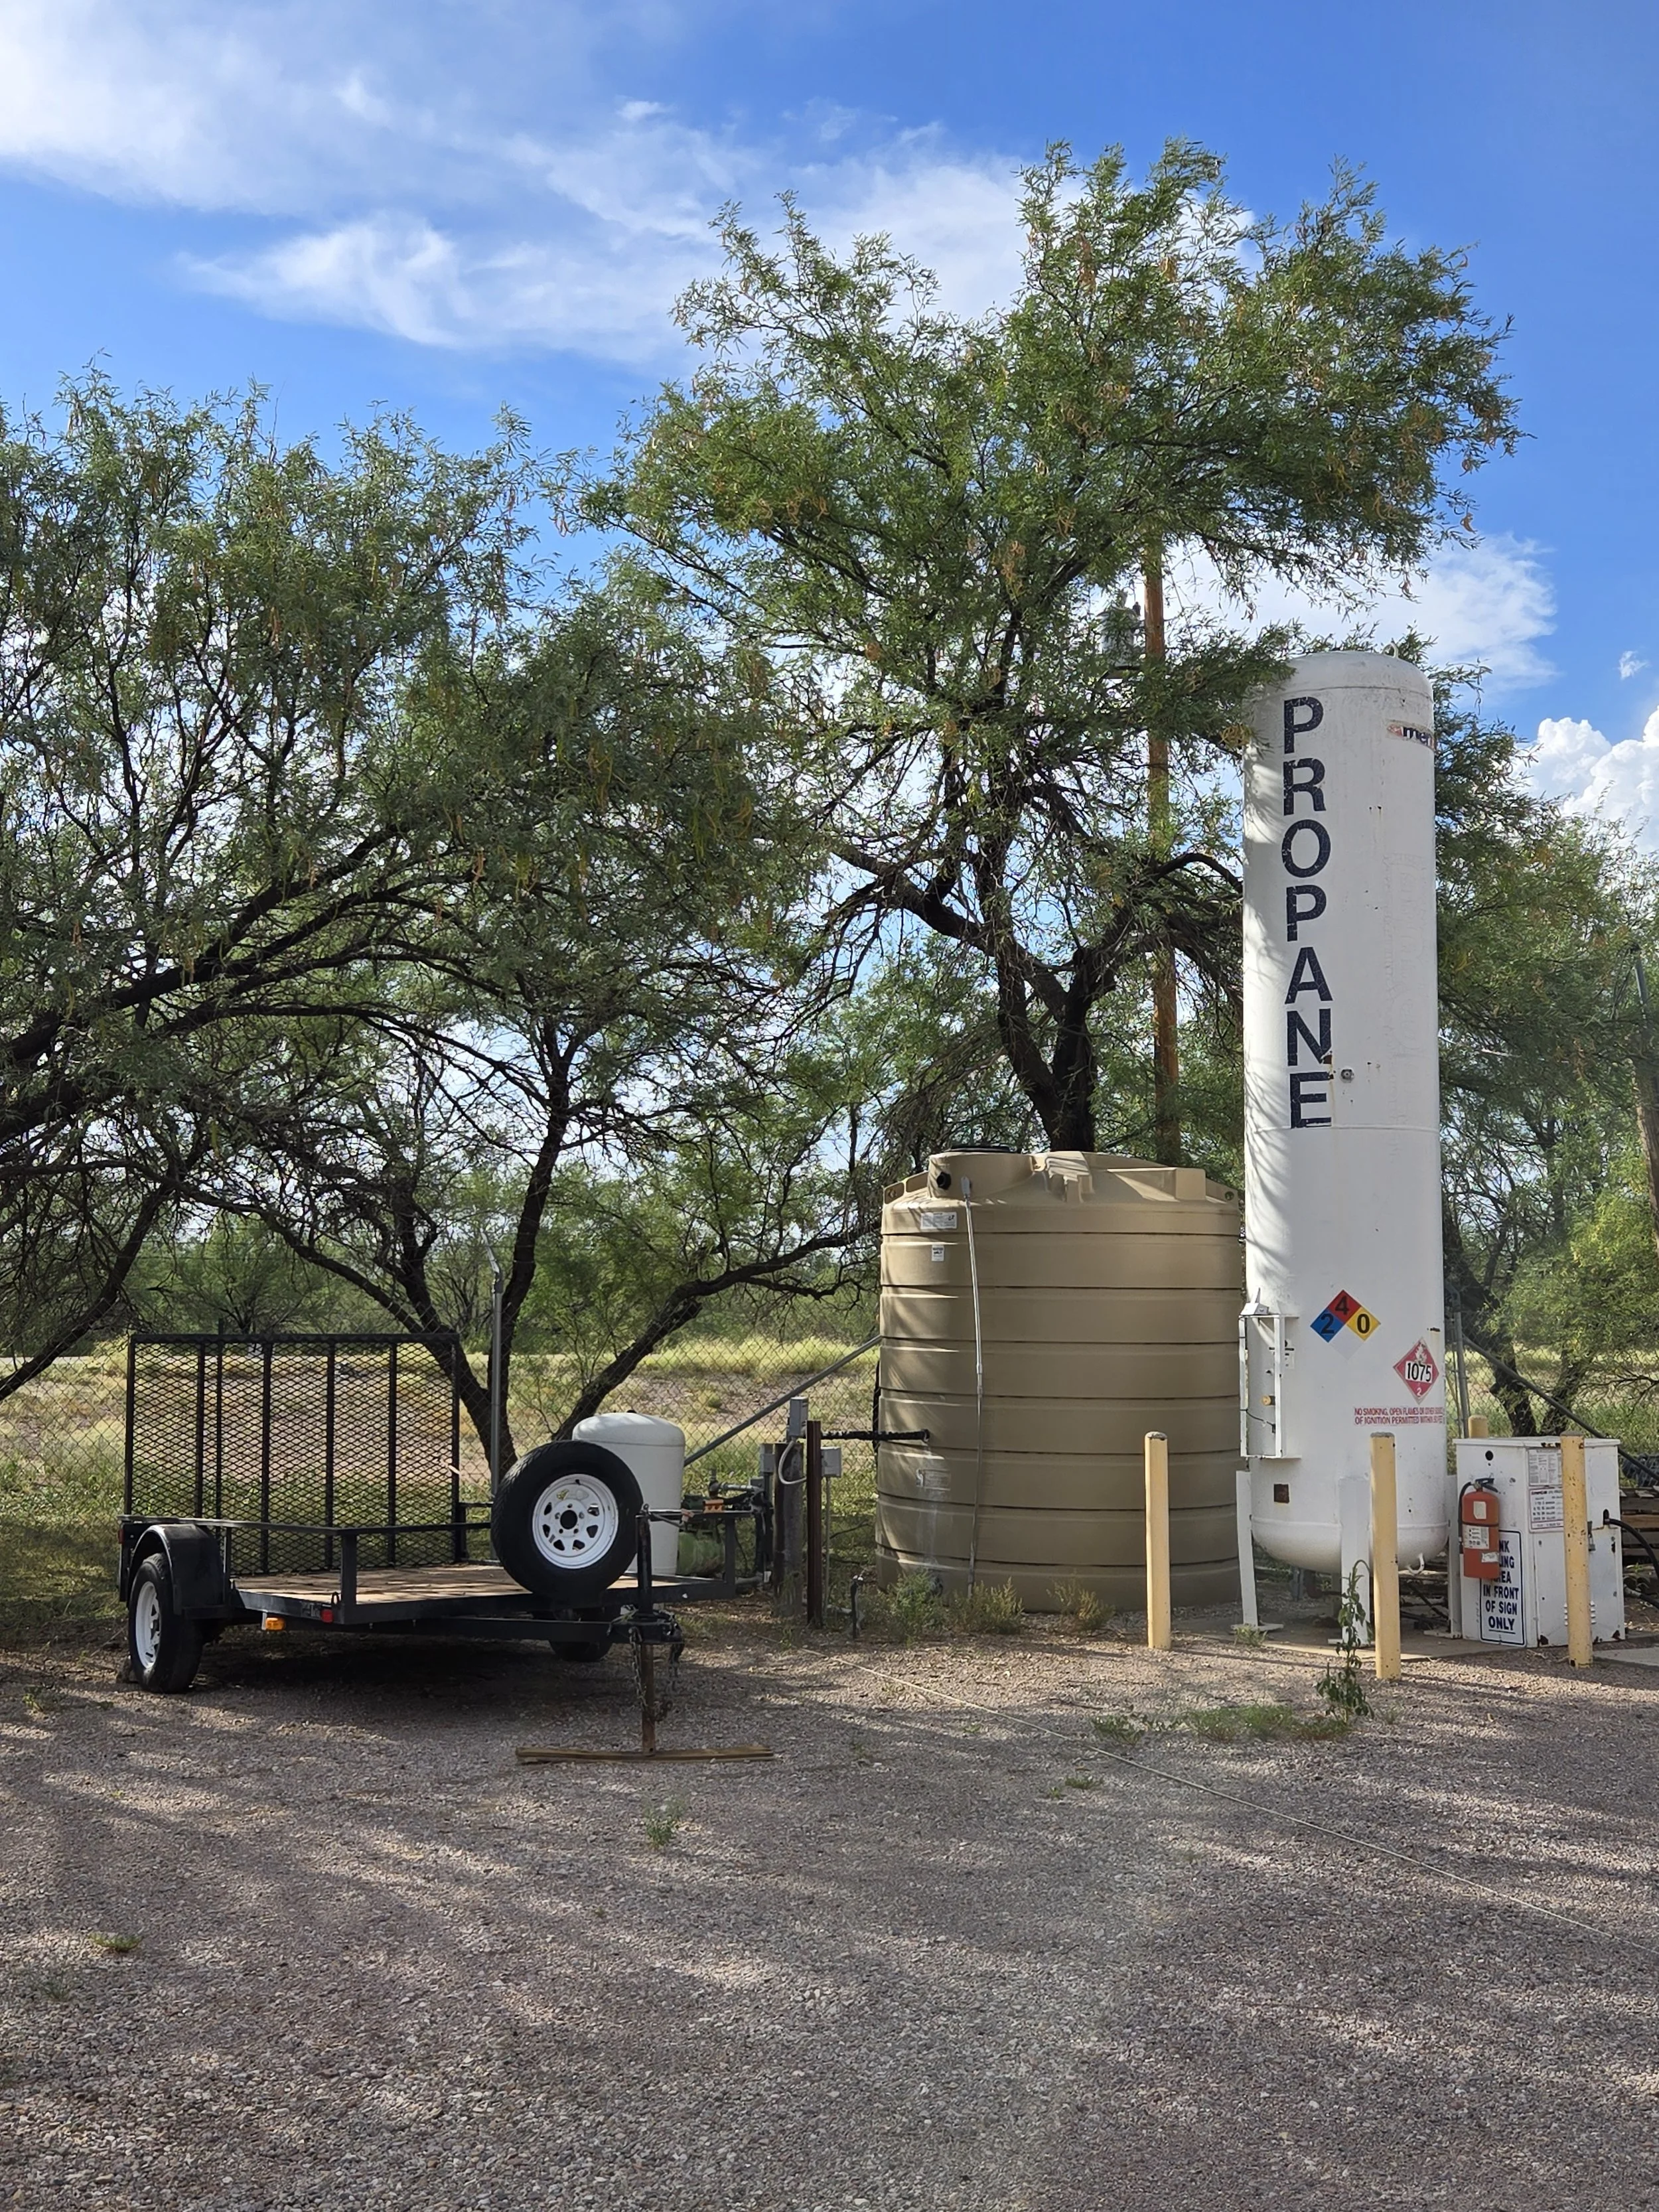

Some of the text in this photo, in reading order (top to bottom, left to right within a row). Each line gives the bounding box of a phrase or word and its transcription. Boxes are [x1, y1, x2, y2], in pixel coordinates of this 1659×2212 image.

[1281, 696, 1333, 1129] PROPANE
[1334, 1295, 1350, 1315] 4
[1321, 1313, 1335, 1334] 2
[1357, 1313, 1370, 1334] 0
[1407, 1362, 1432, 1382] 1075
[1416, 1387, 1422, 1396] 2
[1354, 1416, 1364, 1425] OF
[1499, 1540, 1510, 1553] NK
[1483, 1584, 1519, 1600] IN FRONT
[1485, 1599, 1517, 1615] OF SIGN
[1488, 1615, 1515, 1631] ONLY
